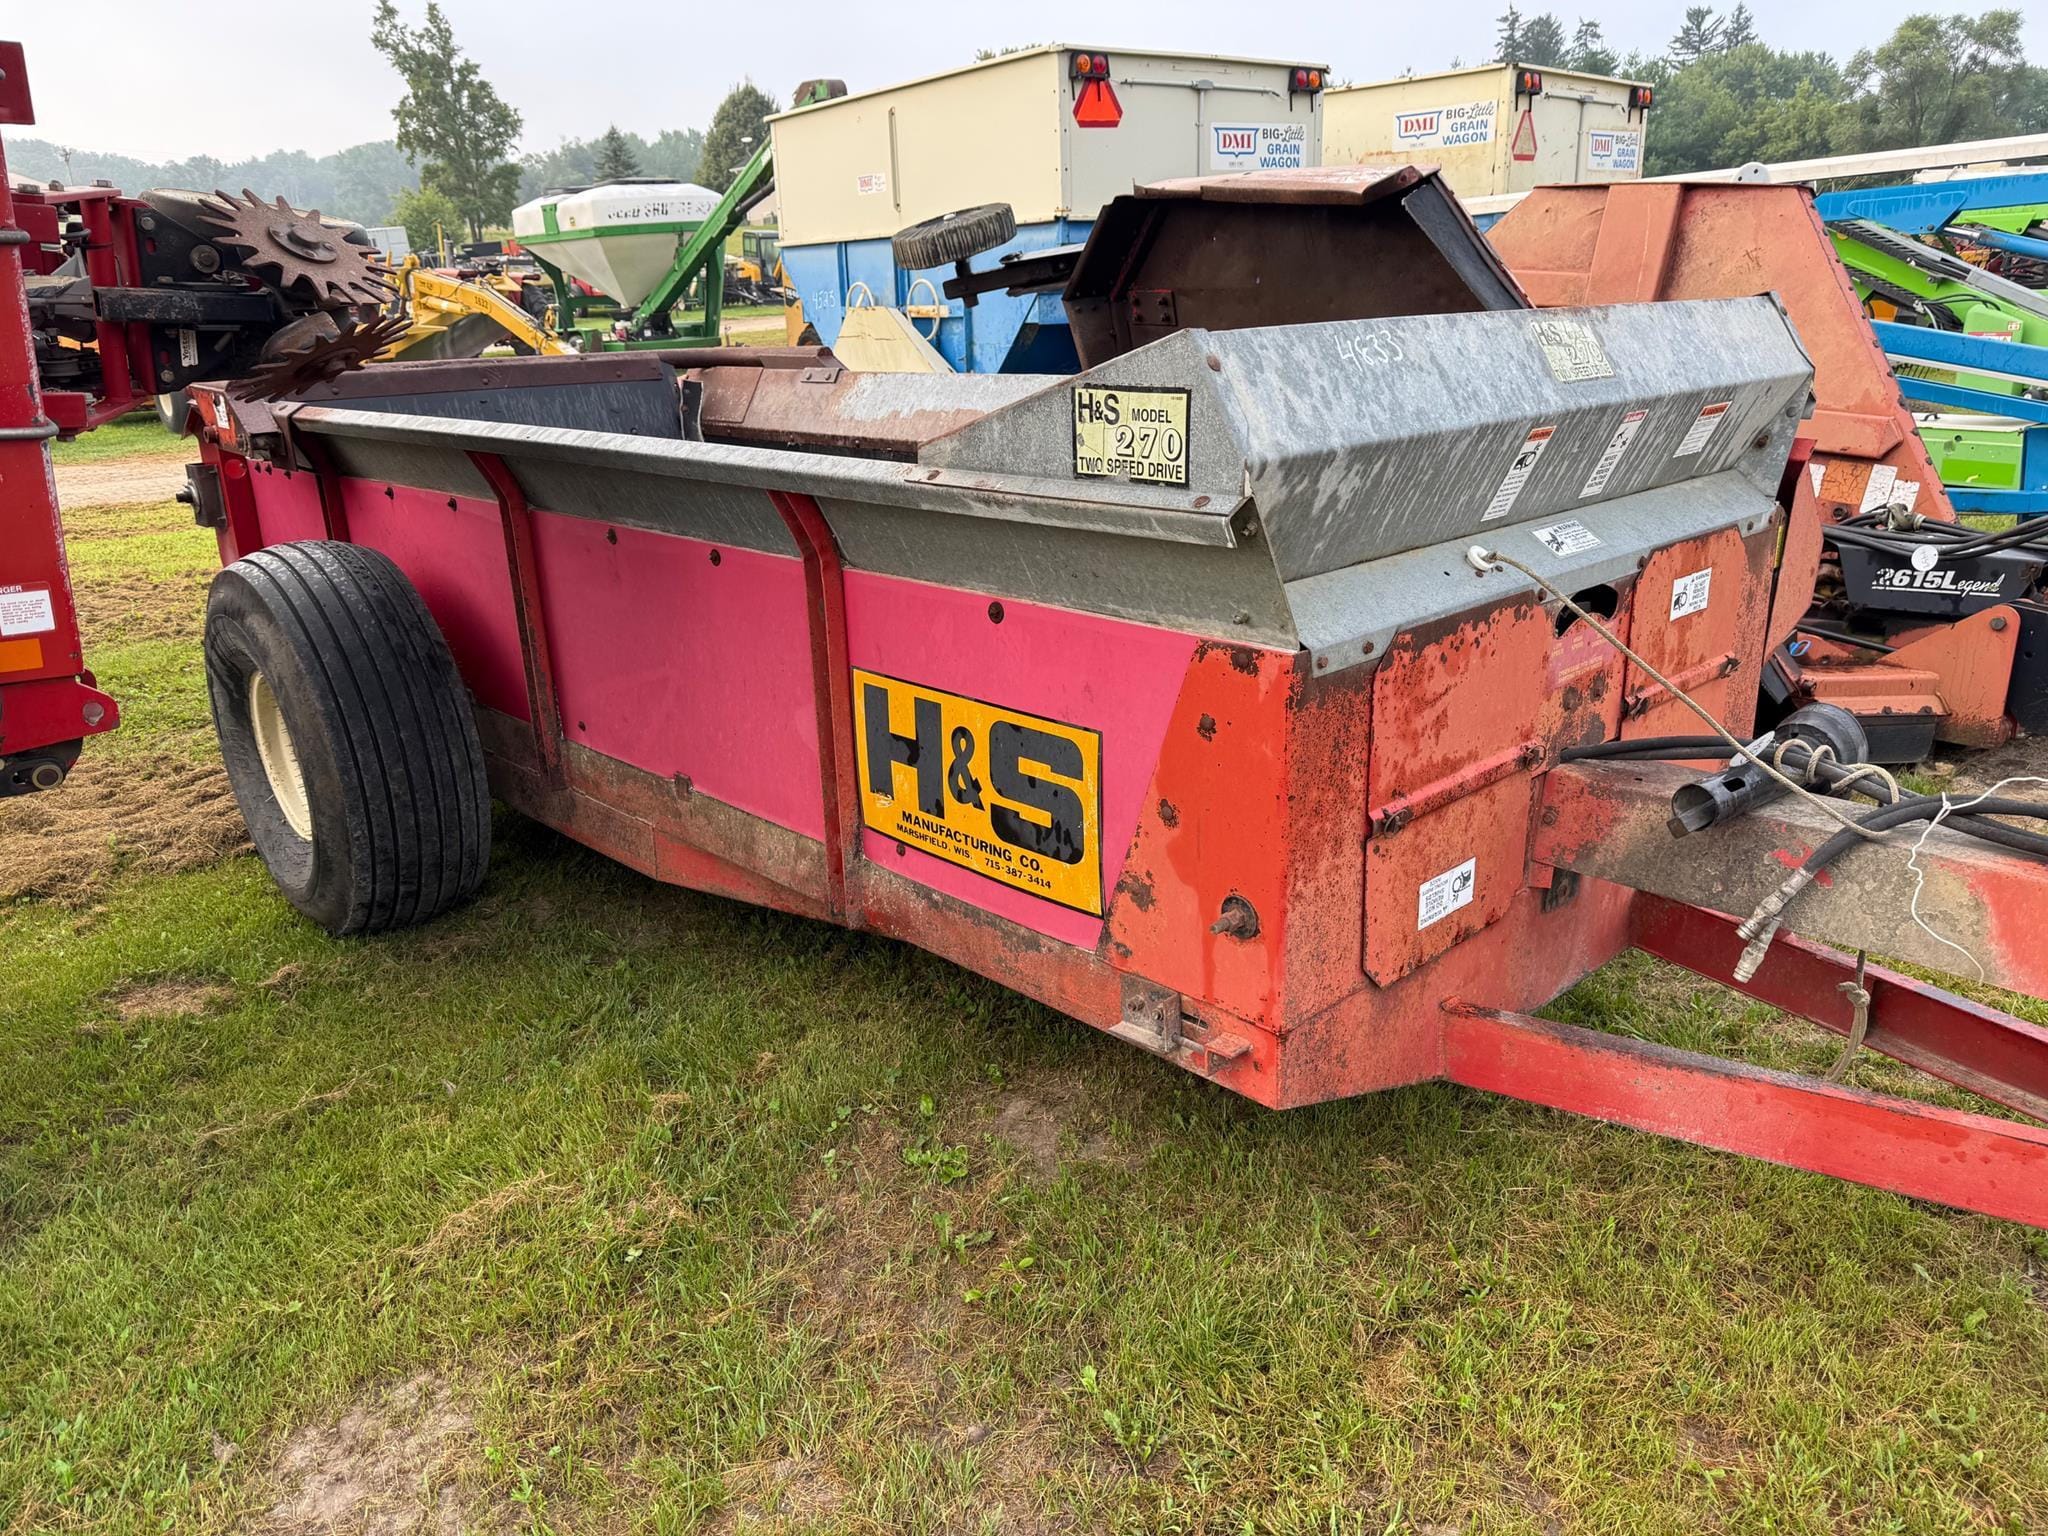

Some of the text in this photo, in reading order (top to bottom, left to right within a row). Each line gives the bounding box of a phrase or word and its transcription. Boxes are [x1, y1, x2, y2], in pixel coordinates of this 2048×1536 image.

[1404, 116, 1434, 133] DMI
[1450, 119, 1488, 133] GRAIN
[1222, 133, 1251, 149] DMI
[1442, 132, 1487, 145] WAGON
[1267, 143, 1300, 155] GRAIN
[1617, 148, 1636, 157] GRAIN
[1260, 157, 1300, 168] WAGON
[1078, 392, 1120, 425] H&S
[1132, 408, 1172, 423] MODEL
[1115, 424, 1183, 462] 270
[1079, 457, 1183, 480] TWO SPEED DRIVE
[864, 683, 1084, 866] H&S
[902, 811, 1044, 873] MANUFACTURING CO.
[954, 845, 973, 860] WIS.
[985, 857, 1052, 889] 715-387-3414
